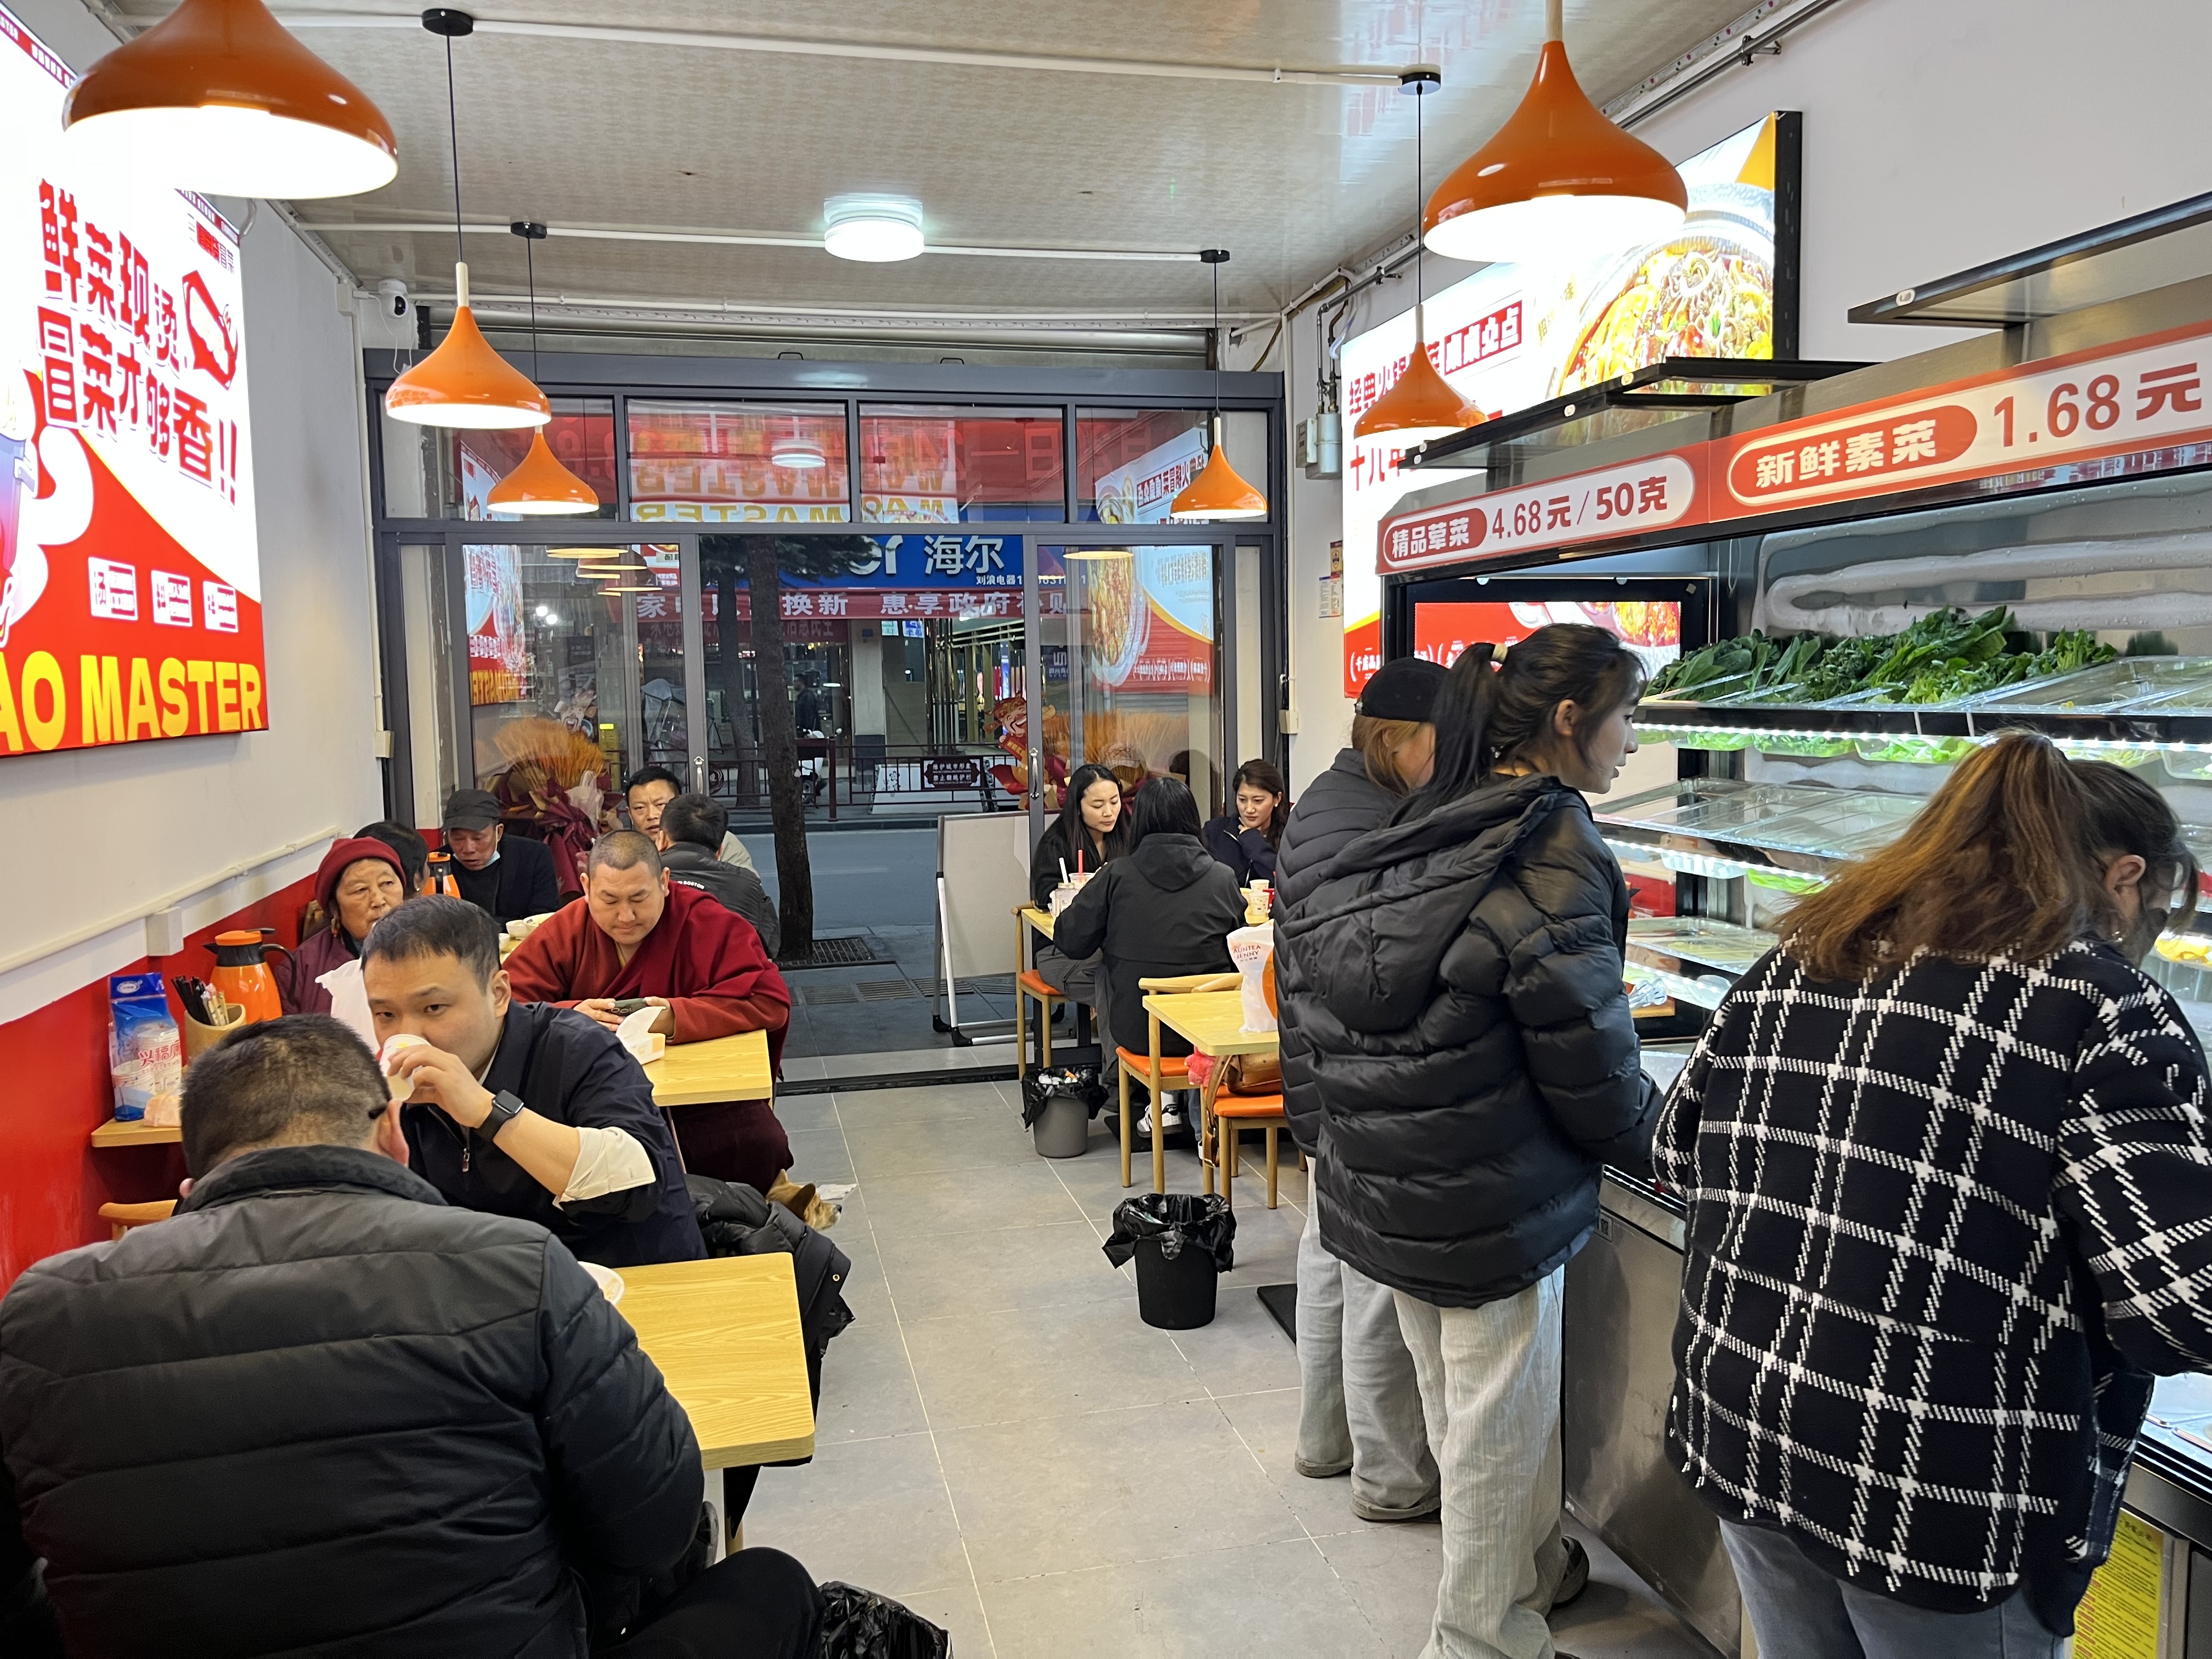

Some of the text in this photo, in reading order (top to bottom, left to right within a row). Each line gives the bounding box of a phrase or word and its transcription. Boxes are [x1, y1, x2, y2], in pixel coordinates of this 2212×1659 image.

[1756, 362, 2202, 488] 新鲜素菜 1.68元
[1391, 516, 1470, 558] 精品荤菜
[1491, 476, 1668, 540] 4.68元/50克
[924, 535, 1005, 575] 海尔
[80, 653, 262, 744] MASTER
[683, 880, 705, 890] BOSTON
[1233, 944, 1261, 954] AUNTEA
[1237, 950, 1259, 959] JENNY
